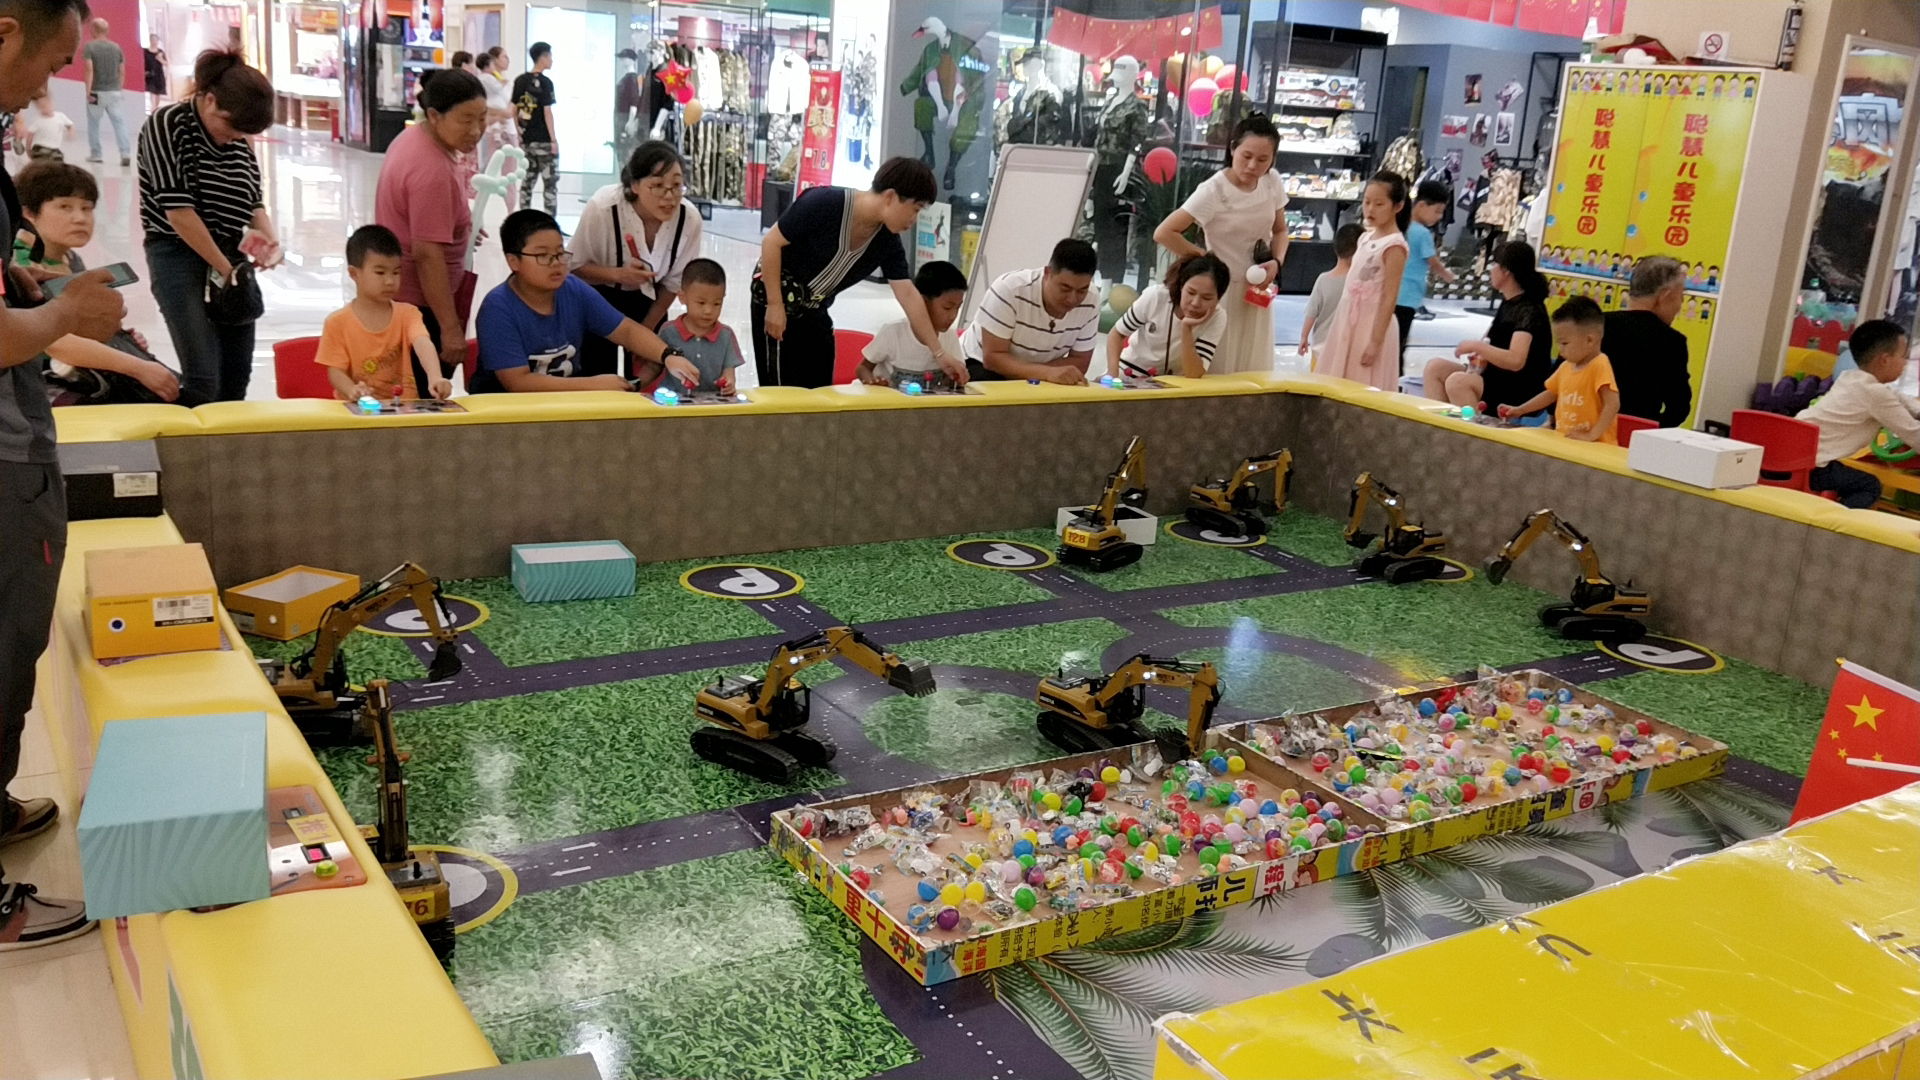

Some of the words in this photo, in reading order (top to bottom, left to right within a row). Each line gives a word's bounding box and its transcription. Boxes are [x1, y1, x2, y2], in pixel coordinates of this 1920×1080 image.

[1577, 108, 1615, 235] 聪慧儿童乐园
[1664, 113, 1708, 247] 聪慧儿童乐园
[1223, 876, 1247, 902] 儿
